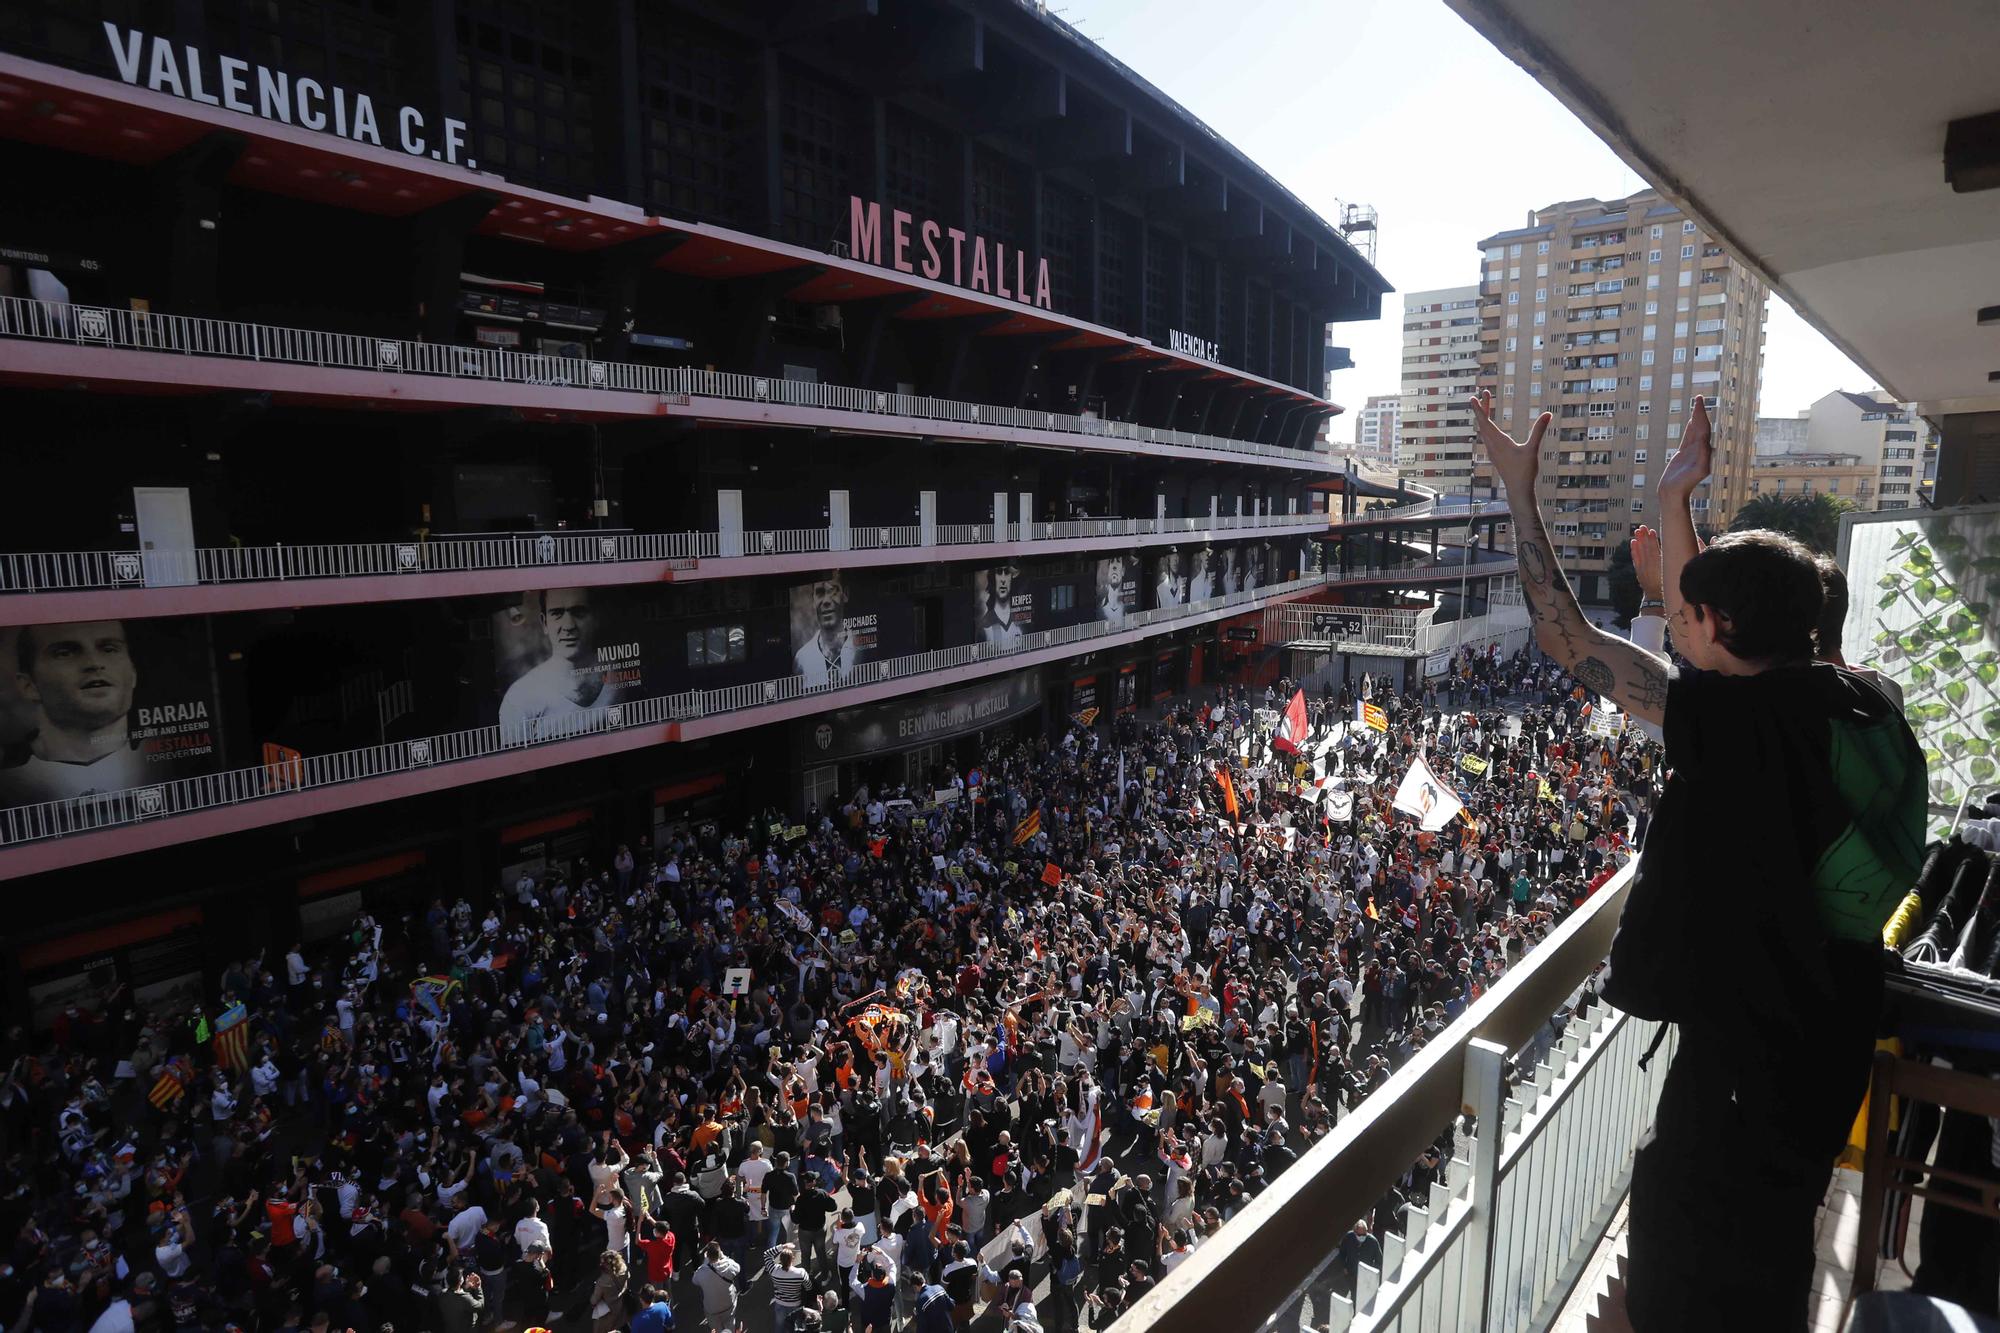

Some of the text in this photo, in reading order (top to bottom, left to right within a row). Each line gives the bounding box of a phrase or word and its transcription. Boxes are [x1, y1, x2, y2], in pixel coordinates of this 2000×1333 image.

[103, 21, 477, 168] VALENCIA C.F.
[851, 195, 1052, 310] MESTALLA
[80, 259, 98, 270] 405
[1169, 329, 1220, 363] VALENCIA C.F.
[1012, 593, 1032, 606] KEMPES
[1348, 621, 1360, 632] 52
[597, 642, 640, 662] MUNDO
[622, 659, 641, 669] LEGEND
[138, 701, 208, 727] BARAJA
[967, 708, 973, 721] A
[974, 694, 1009, 719] MESTALLA
[131, 728, 158, 739] HEART
[160, 725, 177, 736] AND
[179, 720, 210, 733] LEGEND
